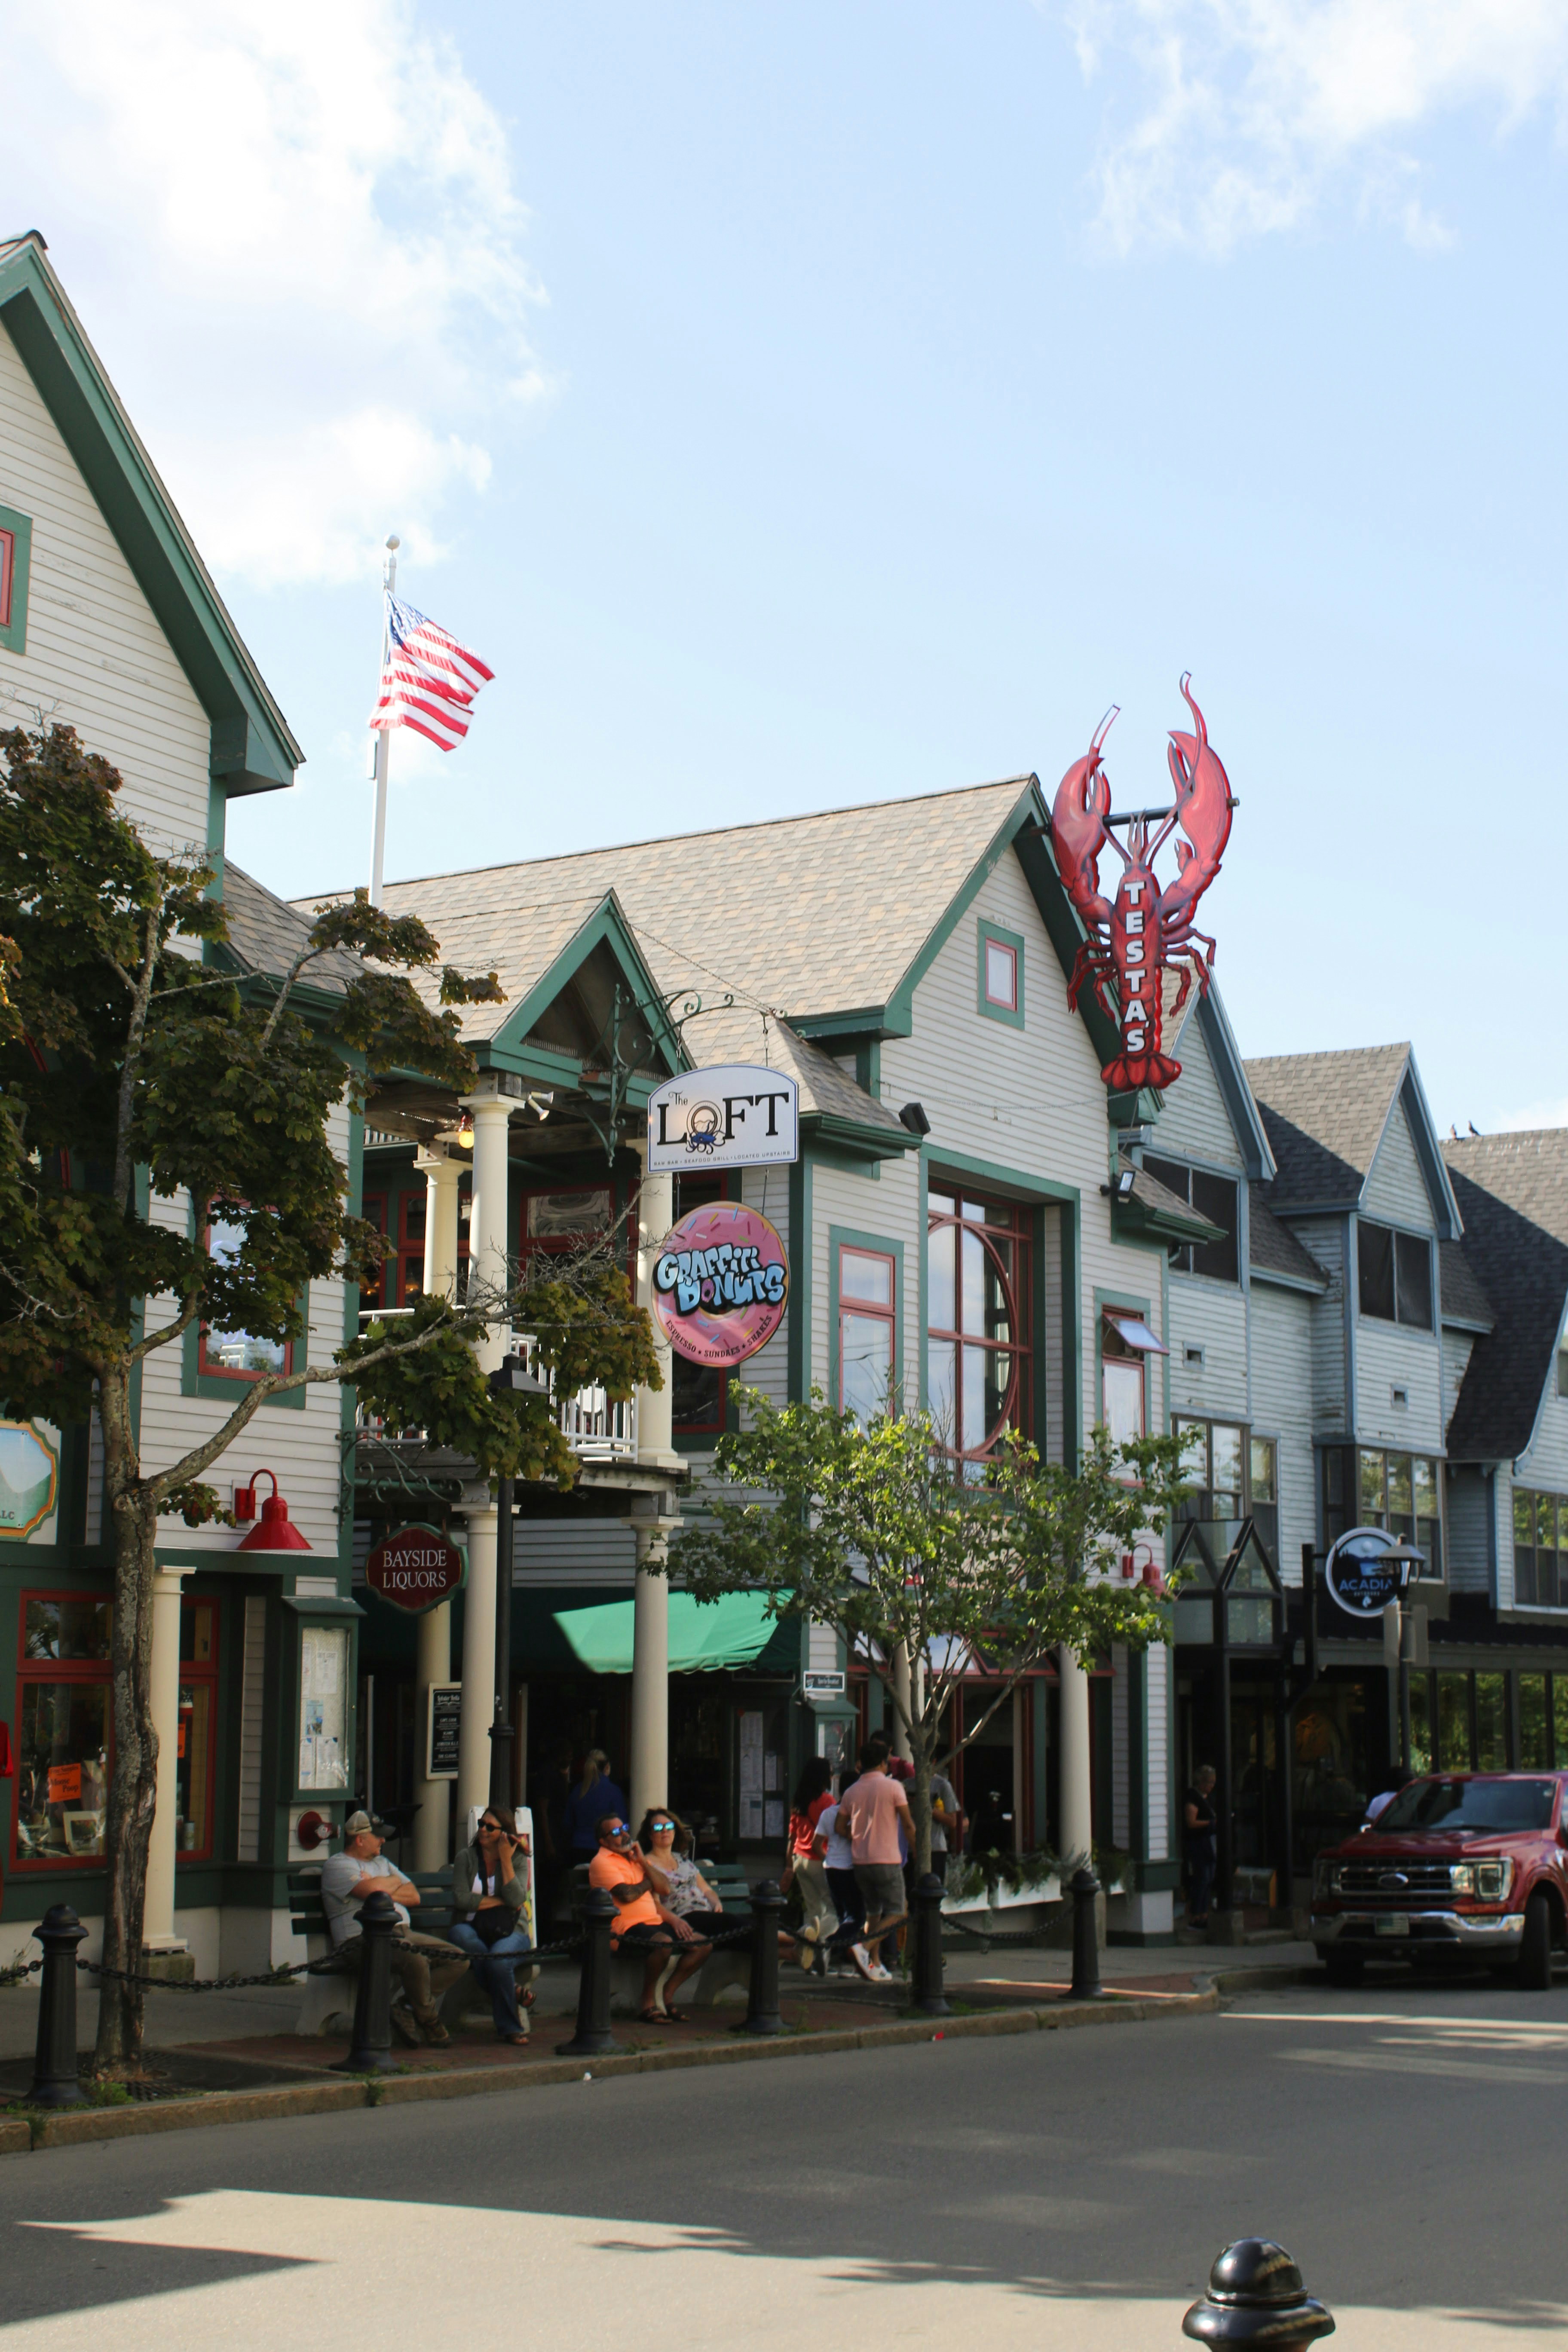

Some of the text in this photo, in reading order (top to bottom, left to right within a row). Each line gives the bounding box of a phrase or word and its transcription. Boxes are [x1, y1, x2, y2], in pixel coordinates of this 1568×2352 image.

[1124, 881, 1149, 1053] TESTA'S
[668, 1091, 688, 1106] The
[657, 1092, 789, 1145] LOFT
[666, 1315, 772, 1358] ESPRESSO SUNDAES SHAKES
[0, 1510, 15, 1520] LC
[383, 1549, 447, 1568] BAYSIDE
[383, 1571, 447, 1590] LIQUORS
